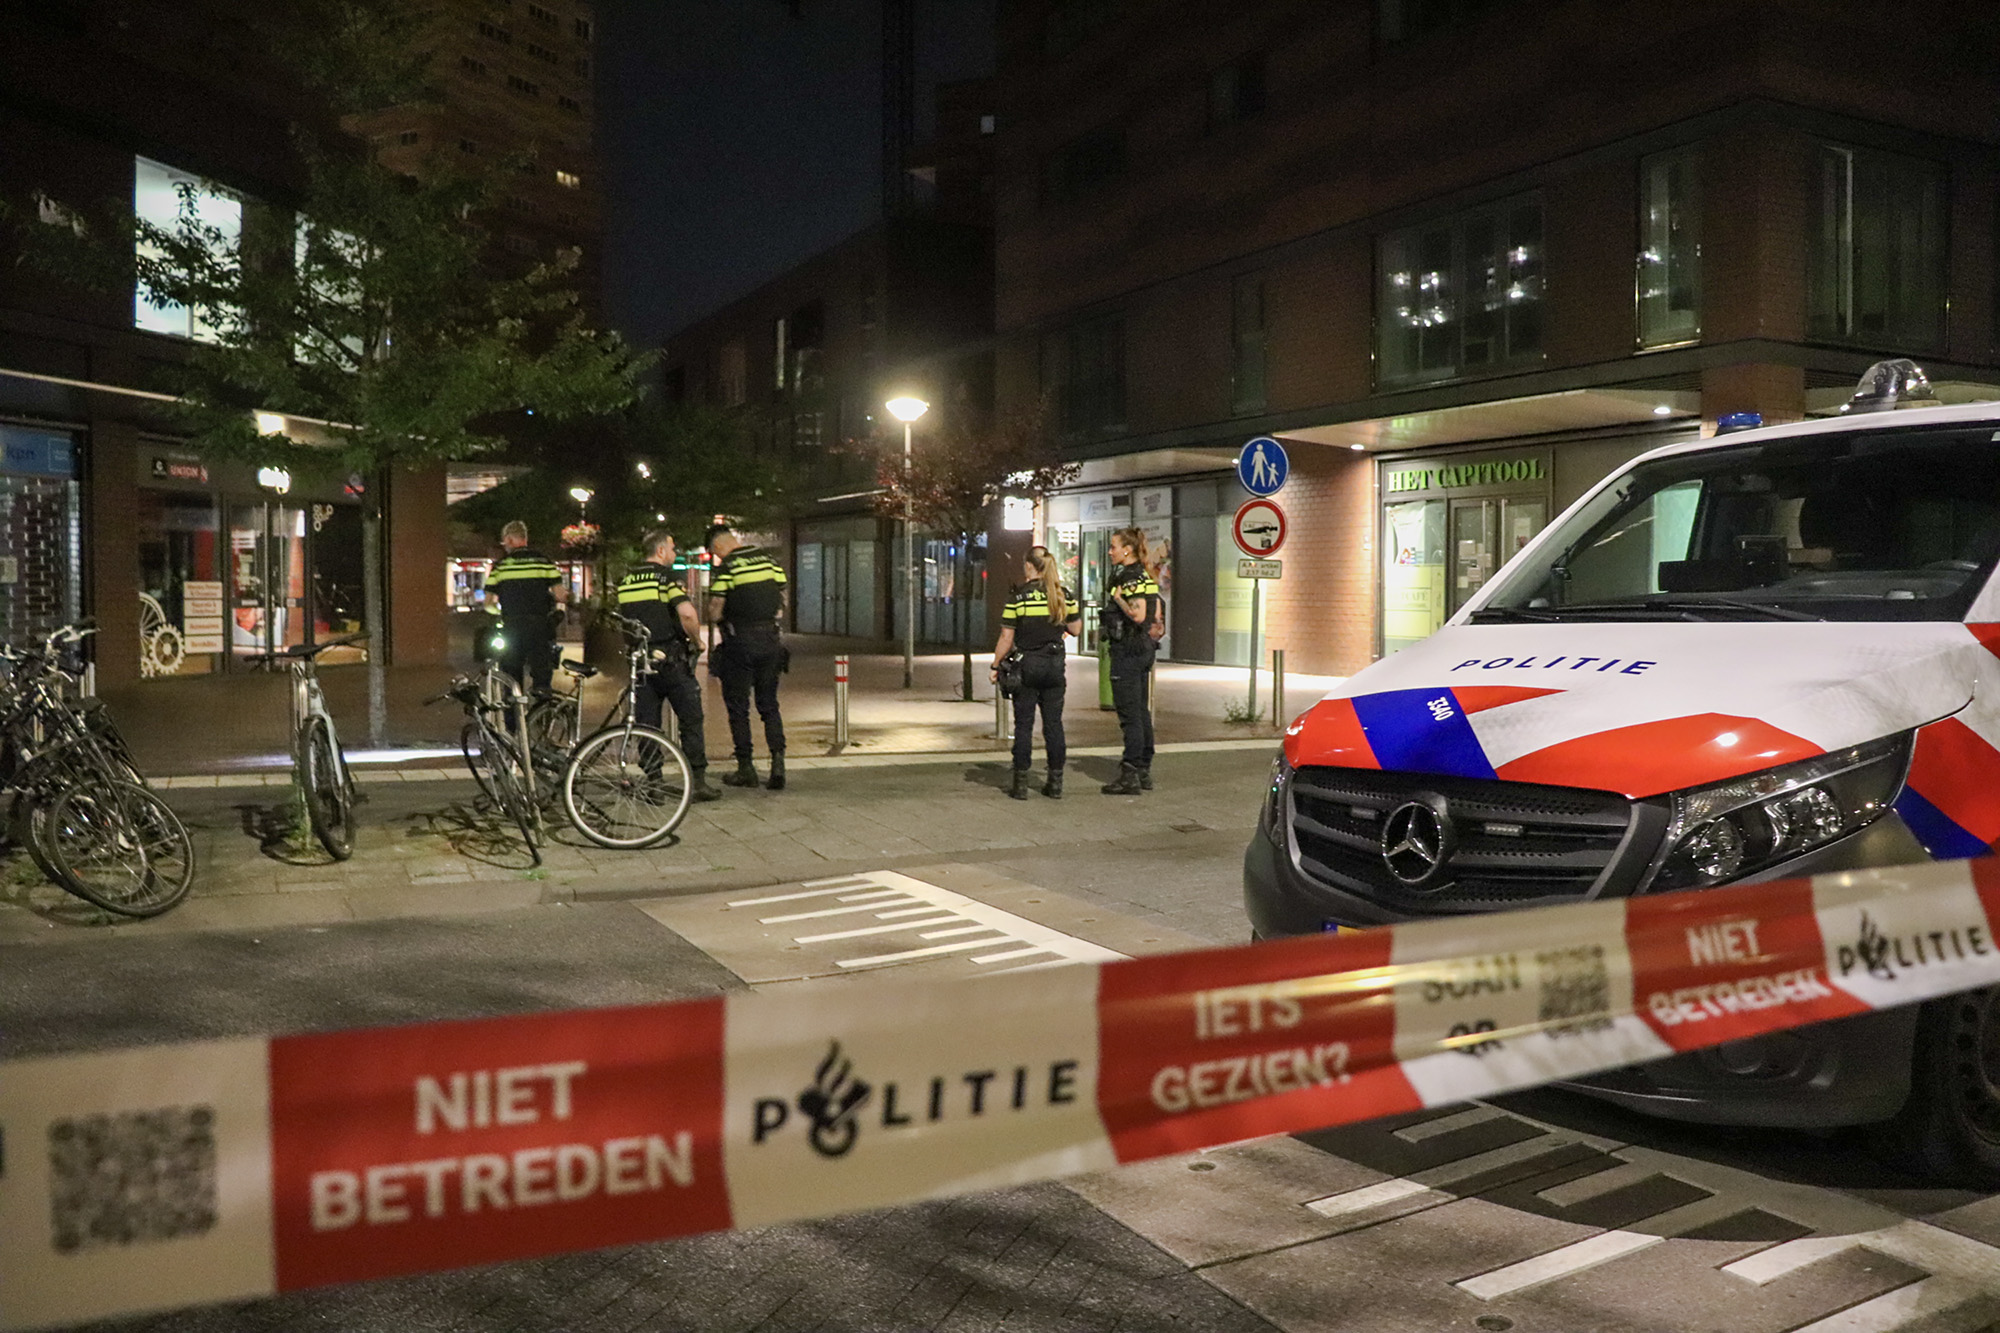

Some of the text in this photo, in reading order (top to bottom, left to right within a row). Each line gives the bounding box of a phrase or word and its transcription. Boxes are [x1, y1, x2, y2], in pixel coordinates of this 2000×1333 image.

[1387, 458, 1547, 492] HET CAPITOOL
[1450, 656, 1657, 675] POLITIE
[1427, 696, 1454, 721] 3340
[1684, 919, 1761, 967] NIET
[1194, 978, 1303, 1042] IETS
[415, 1060, 589, 1135] NIET
[1151, 1041, 1351, 1113] GEZIEN?
[310, 1130, 695, 1232] BETREDEN
